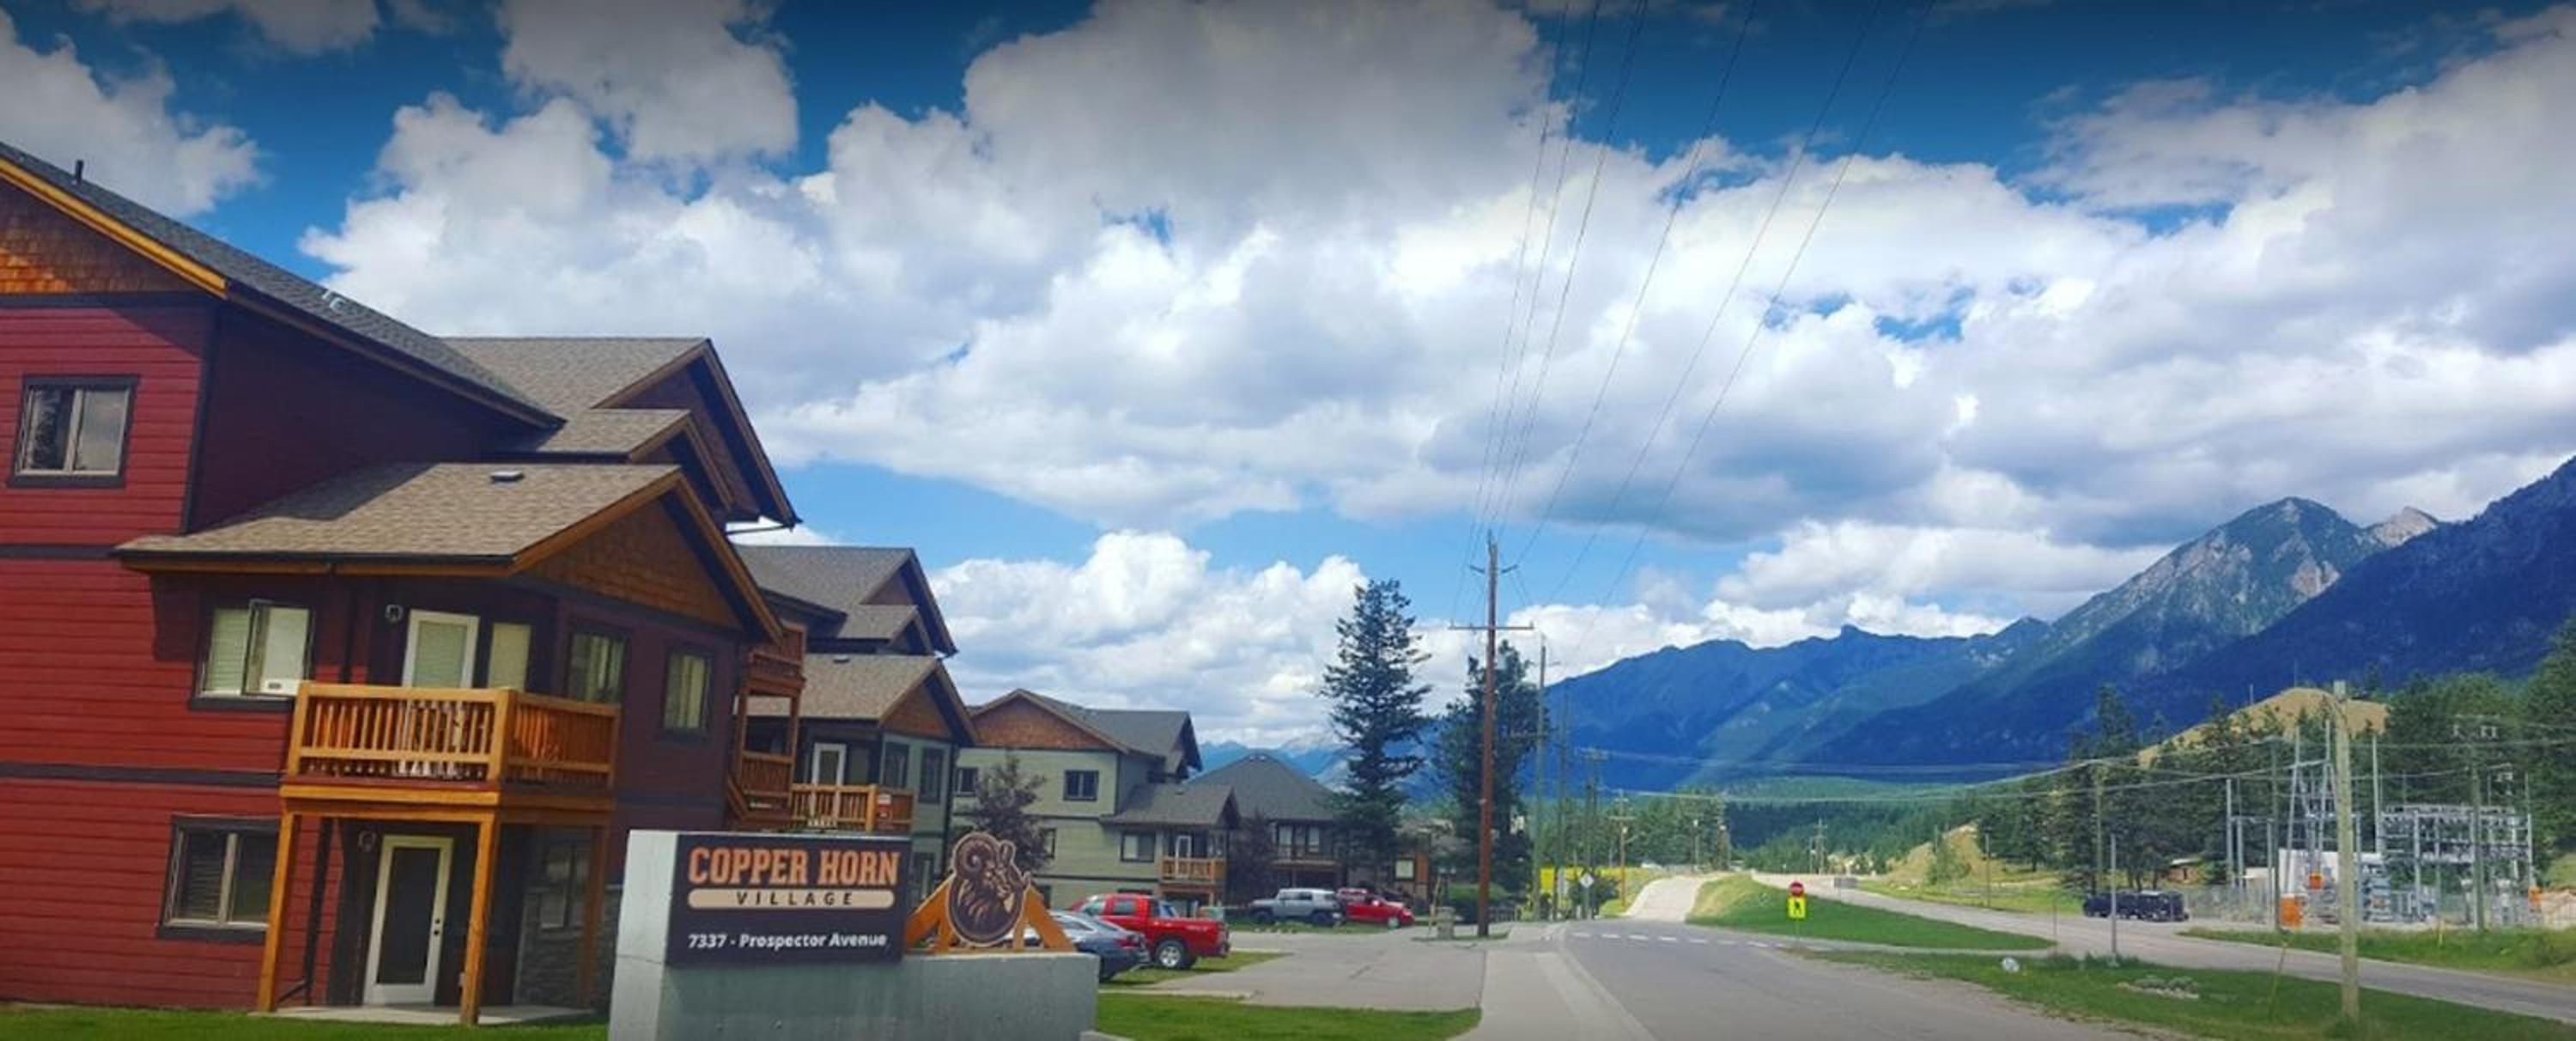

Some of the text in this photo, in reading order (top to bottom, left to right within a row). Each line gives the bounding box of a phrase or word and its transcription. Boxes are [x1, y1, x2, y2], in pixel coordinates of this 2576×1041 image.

[688, 847, 901, 886] COPPER HORN
[737, 892, 853, 906] VILLAGE
[688, 934, 727, 949] 7337
[739, 933, 826, 951] Prospector
[827, 932, 889, 947] Avenue
